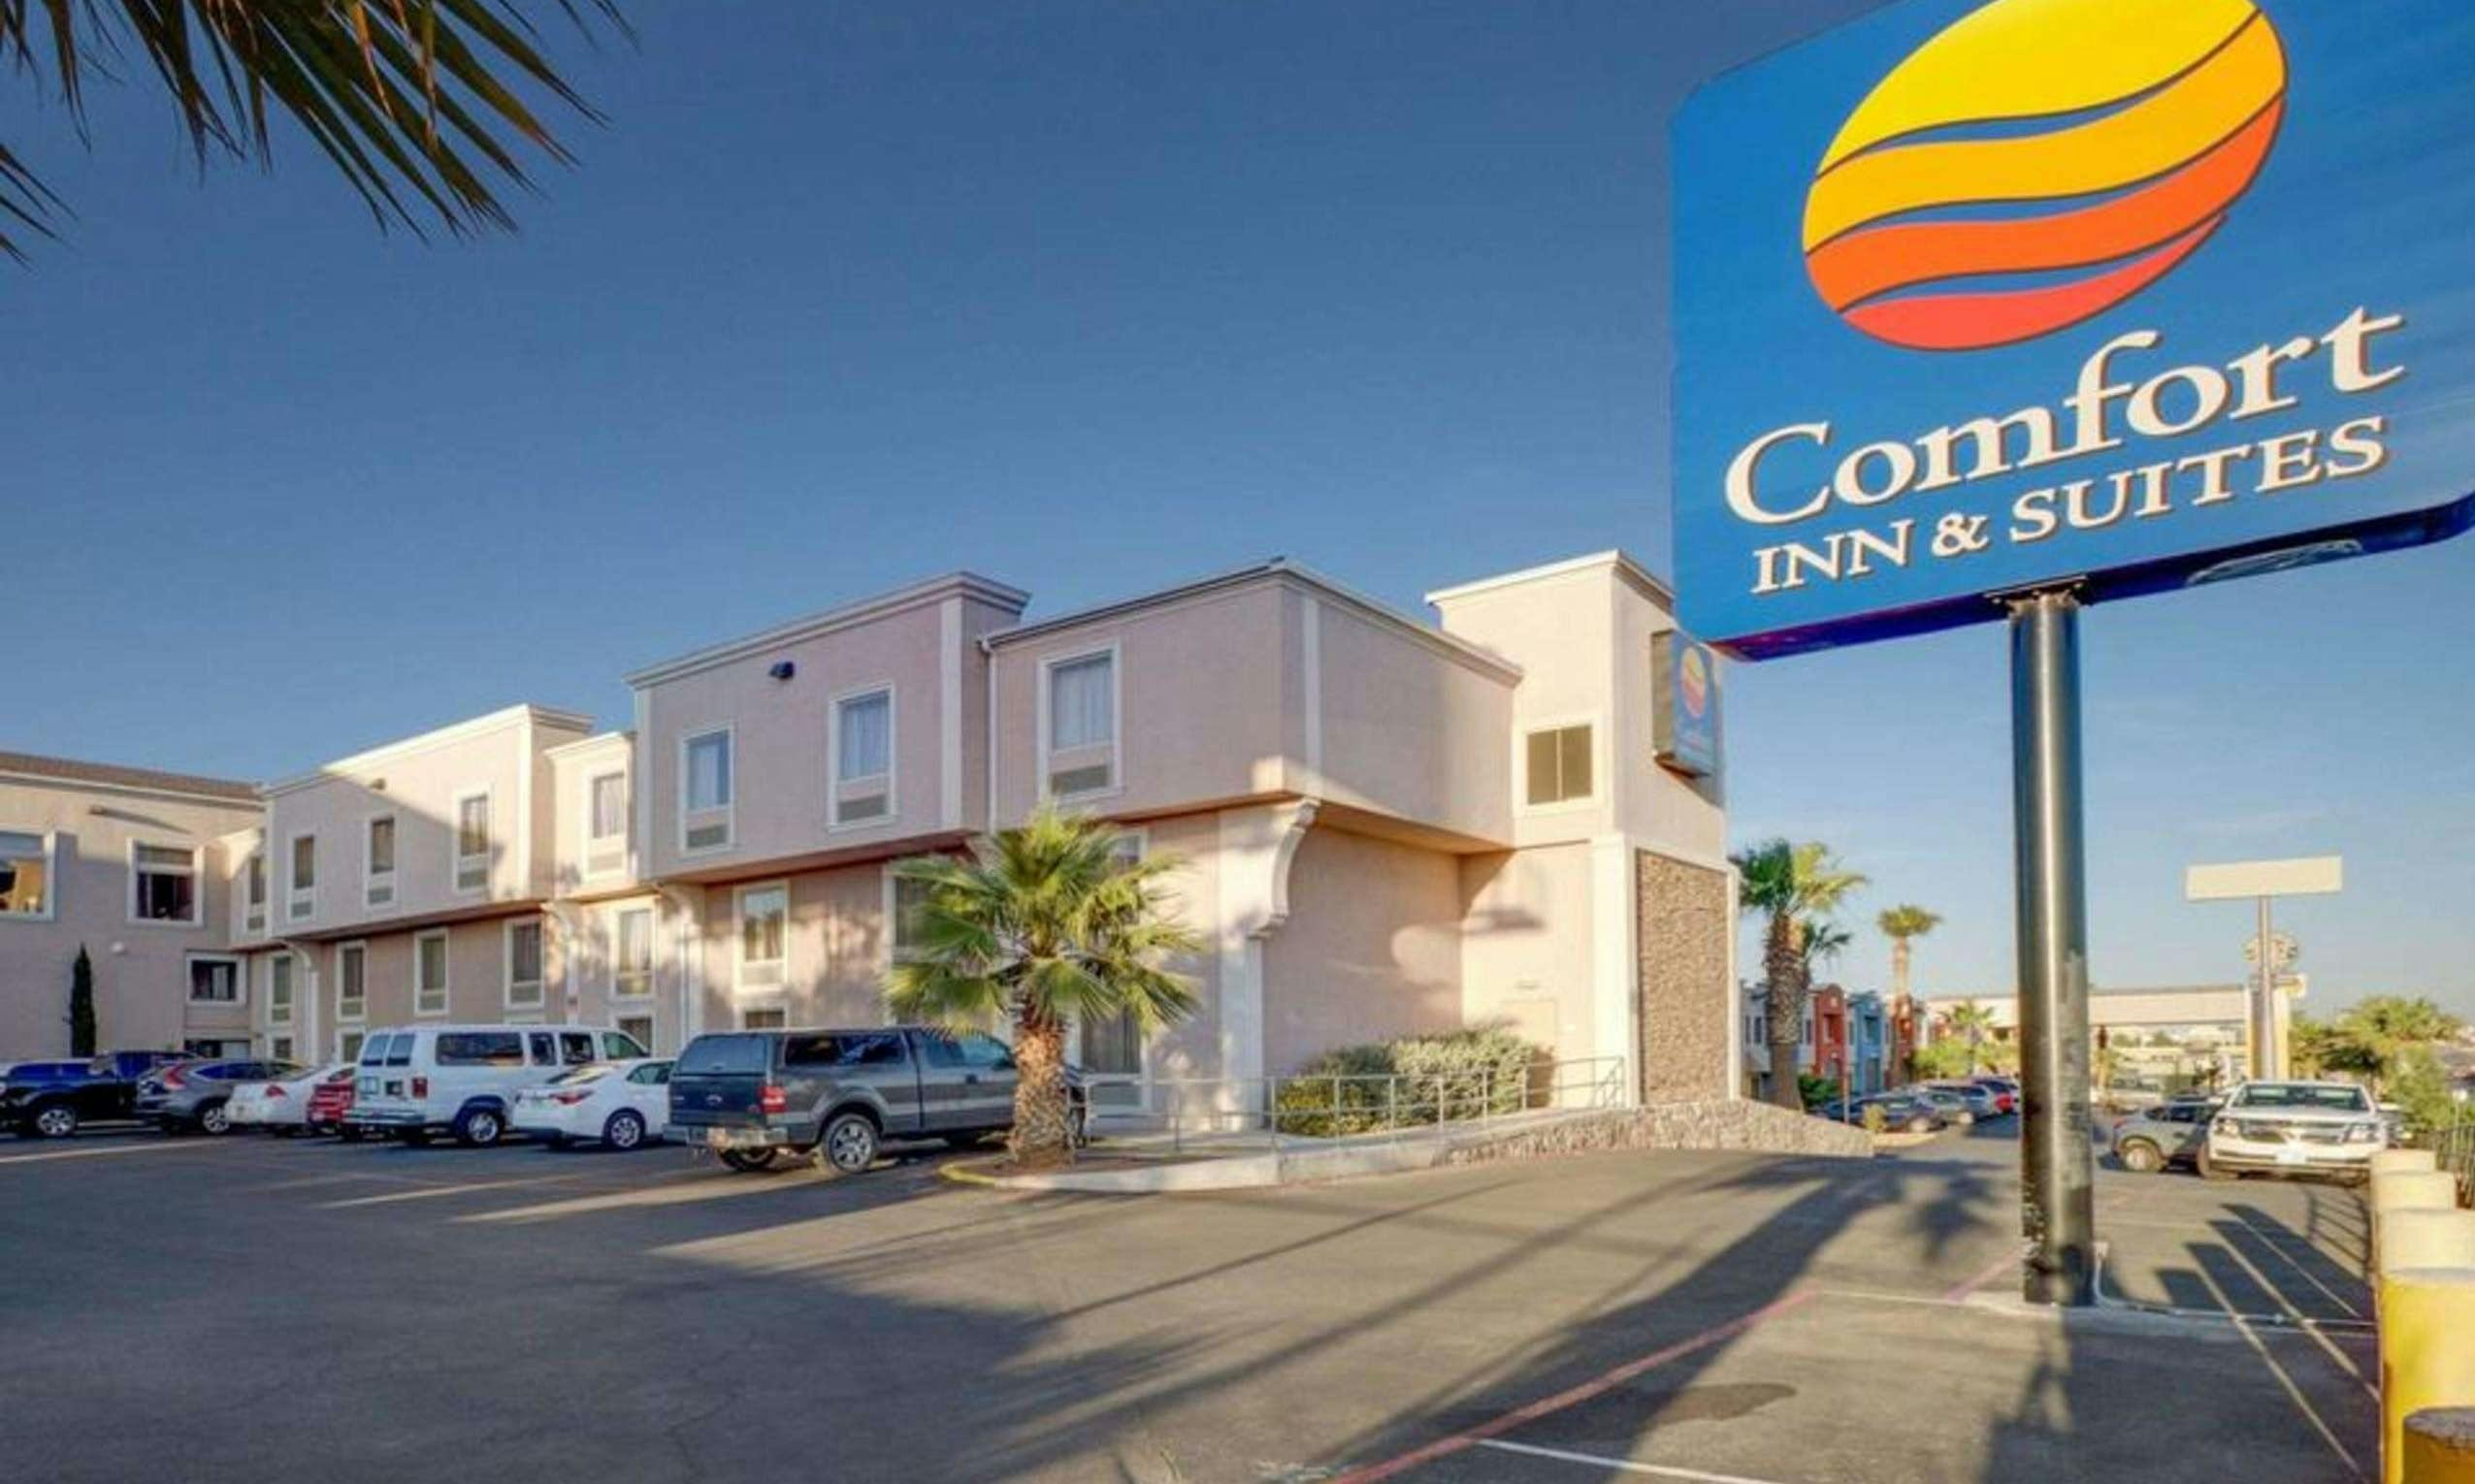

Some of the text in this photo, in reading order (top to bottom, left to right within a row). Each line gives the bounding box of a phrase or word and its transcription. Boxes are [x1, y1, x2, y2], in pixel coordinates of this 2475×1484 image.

[1724, 305, 2406, 526] Comfort
[1750, 415, 2390, 595] INN & SUITES
